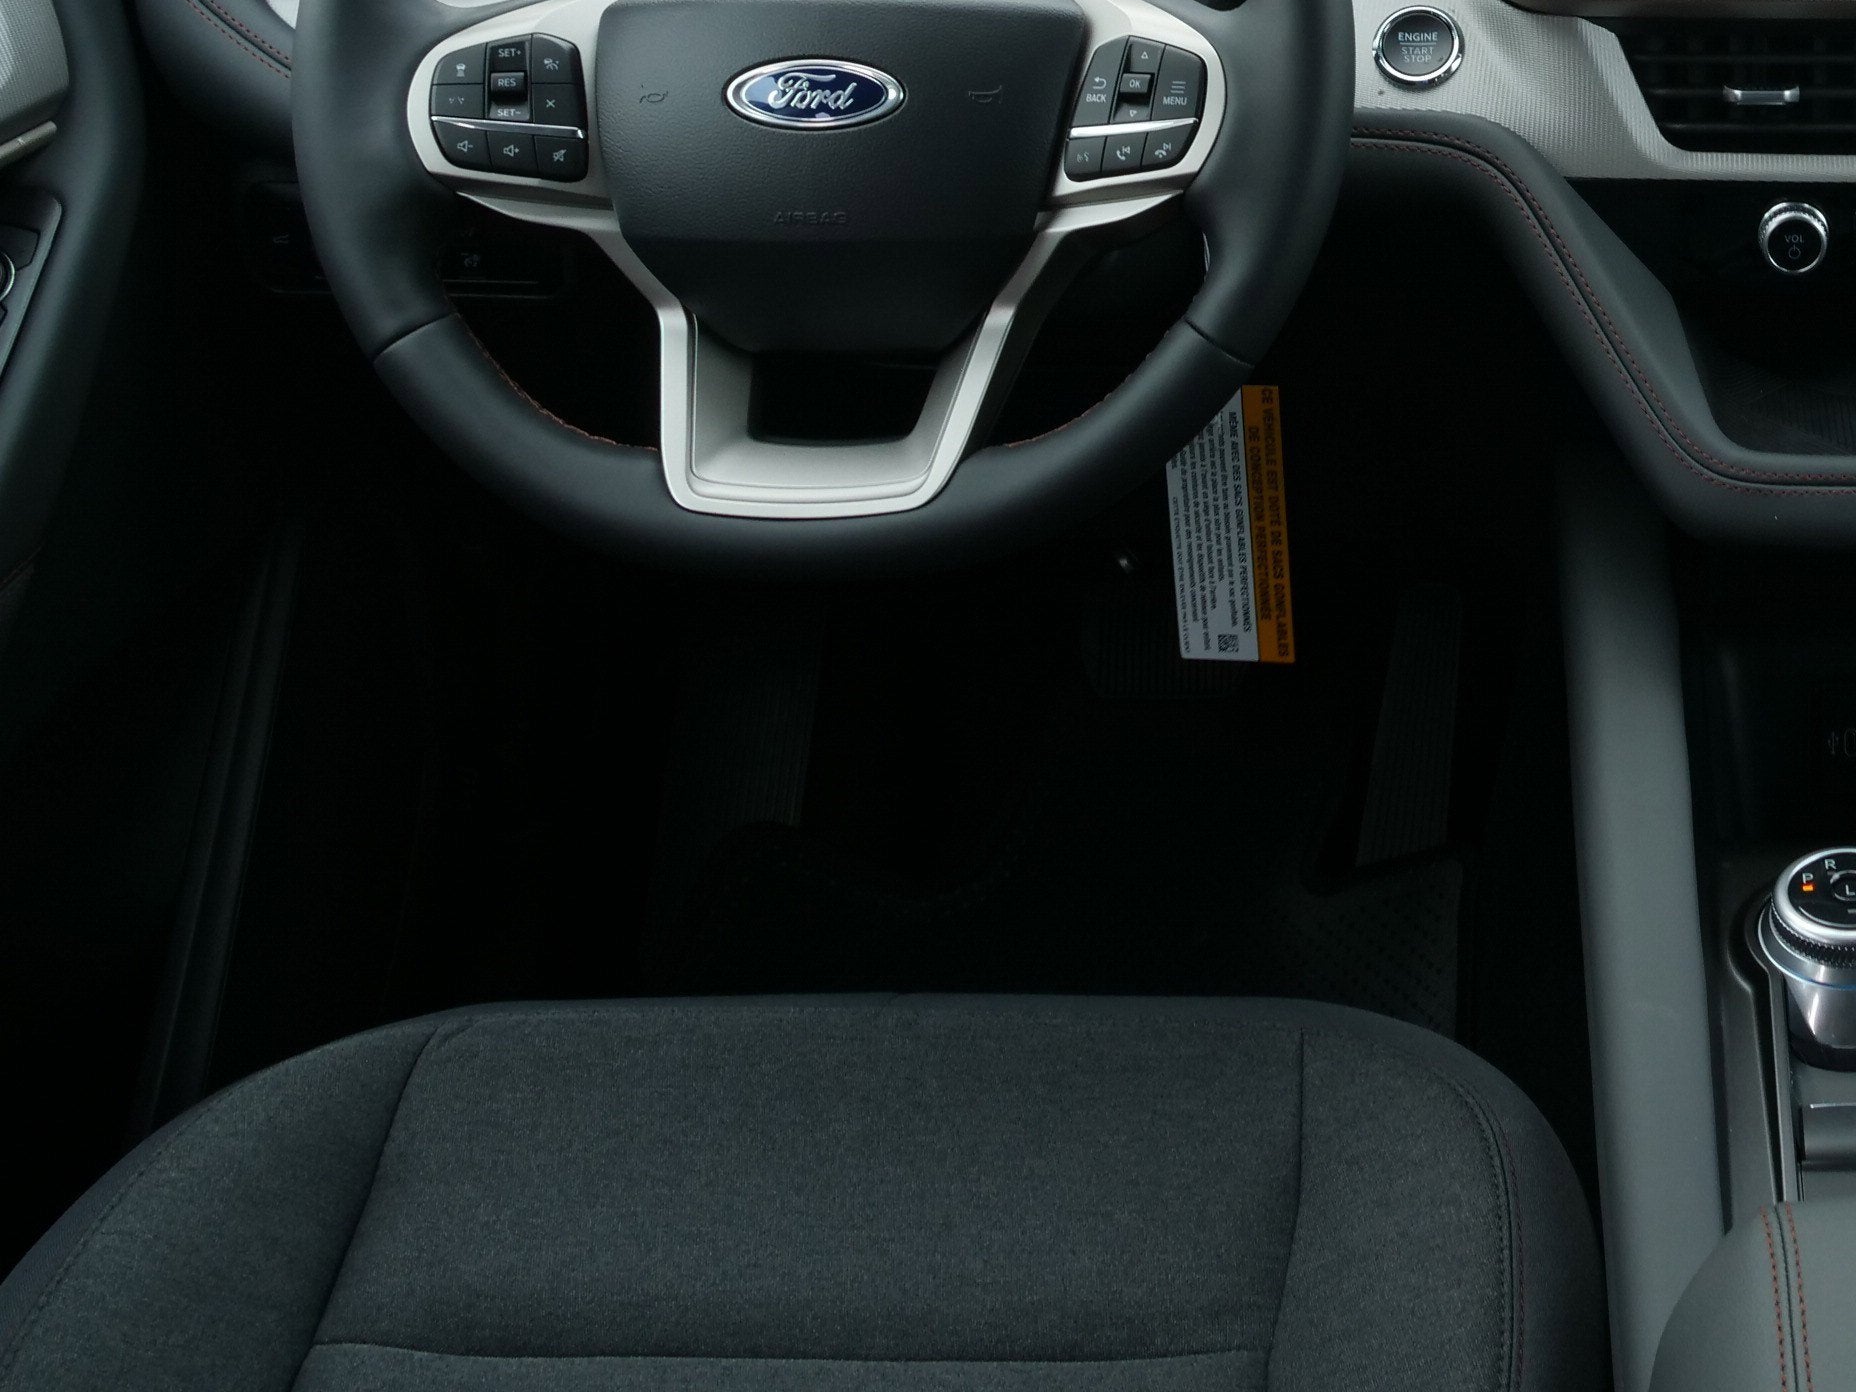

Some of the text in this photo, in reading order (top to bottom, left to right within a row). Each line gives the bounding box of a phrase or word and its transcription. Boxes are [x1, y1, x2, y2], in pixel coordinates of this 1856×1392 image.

[1398, 31, 1438, 42] ENGINE
[498, 48, 521, 58] SET+
[1401, 46, 1434, 55] START
[1404, 55, 1432, 63] STOP
[498, 78, 516, 87] RES
[1129, 78, 1142, 88] OK
[767, 70, 856, 111] Ford
[1086, 93, 1107, 104] BACK
[1162, 95, 1188, 106] MENU
[772, 212, 848, 226] AIRBAG
[1784, 234, 1804, 244] VOL
[1232, 465, 1241, 481] DES
[1267, 470, 1279, 491] EST
[1271, 530, 1282, 545] DE
[1802, 873, 1814, 884] P
[1825, 859, 1837, 870] R
[1845, 884, 1856, 896] L
